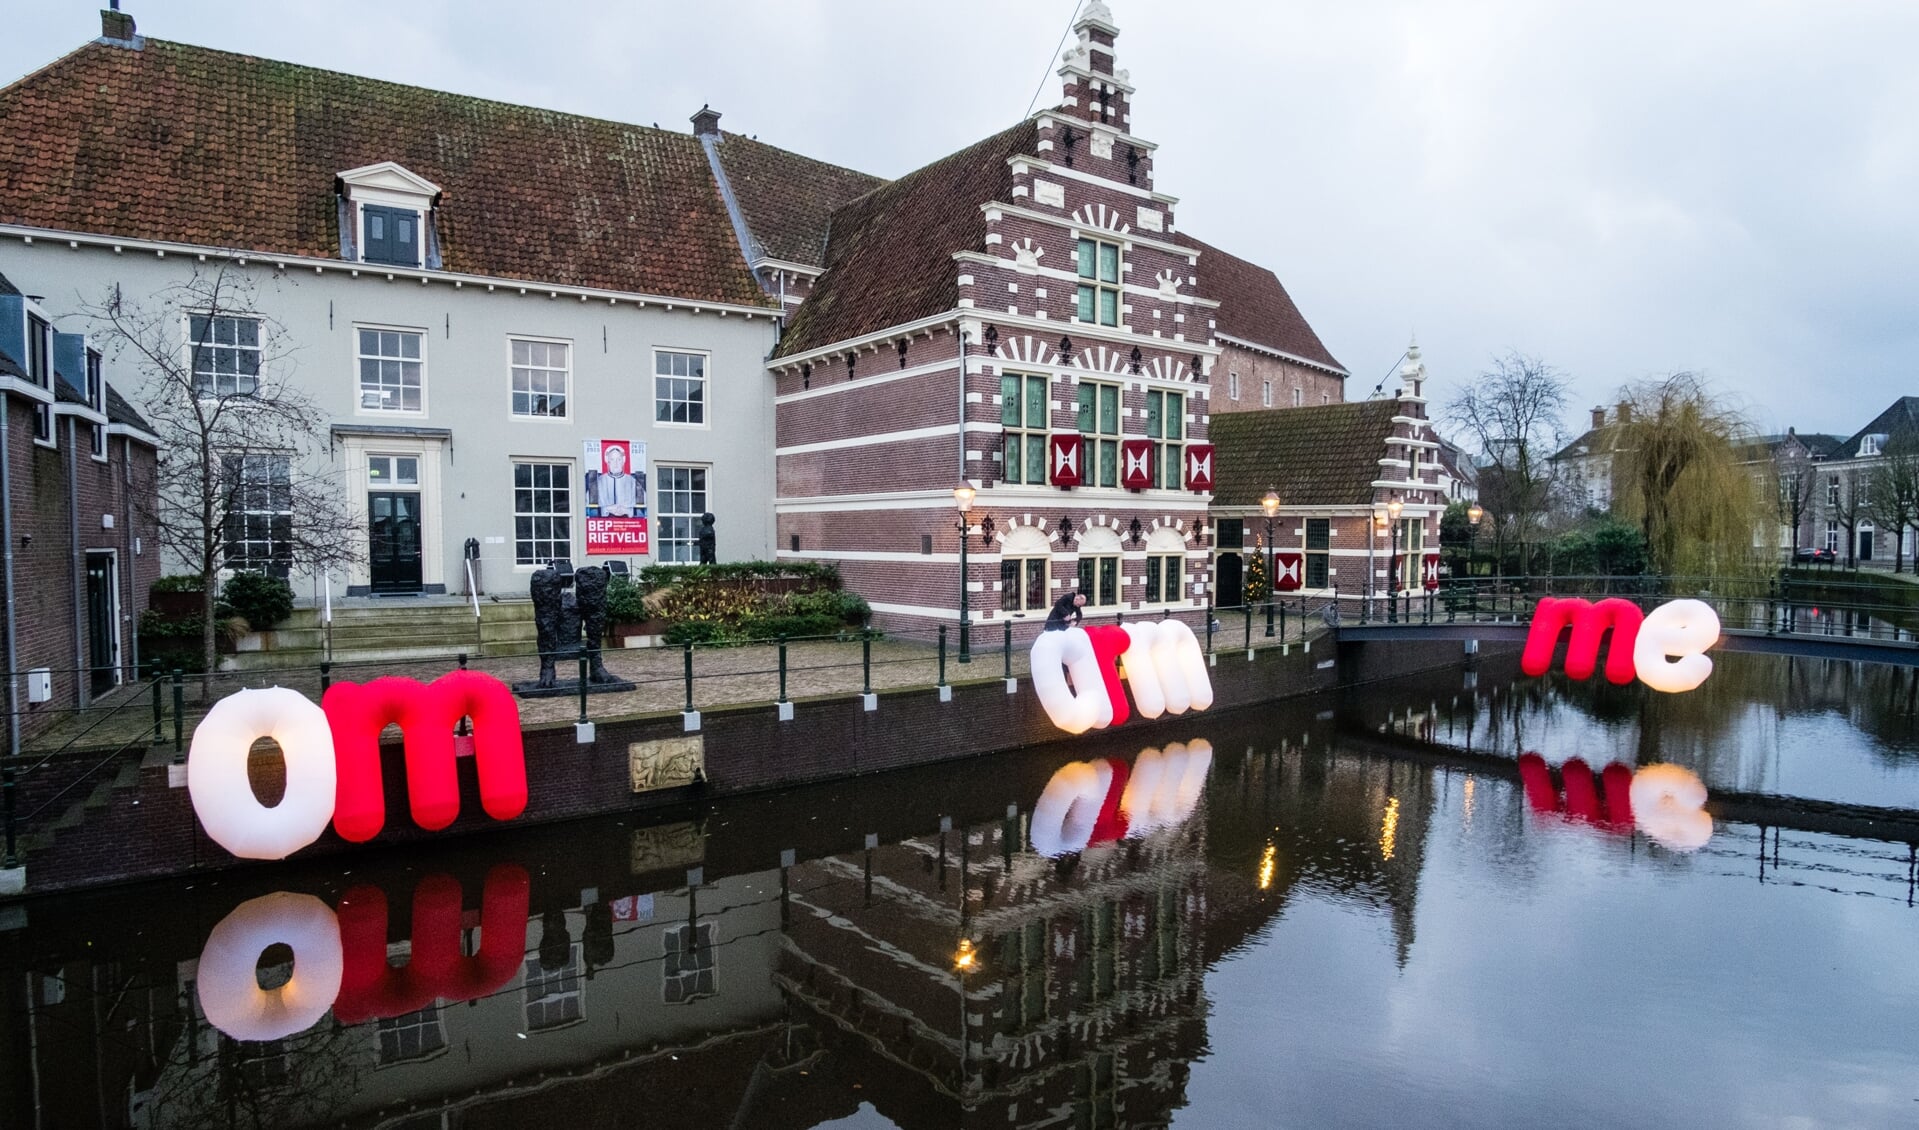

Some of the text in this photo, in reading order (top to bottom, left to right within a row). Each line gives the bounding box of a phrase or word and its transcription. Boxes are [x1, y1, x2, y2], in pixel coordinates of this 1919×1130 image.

[588, 520, 613, 532] BEP
[588, 532, 647, 544] RIETVELD
[1522, 596, 1721, 694] me
[187, 669, 529, 860] om
